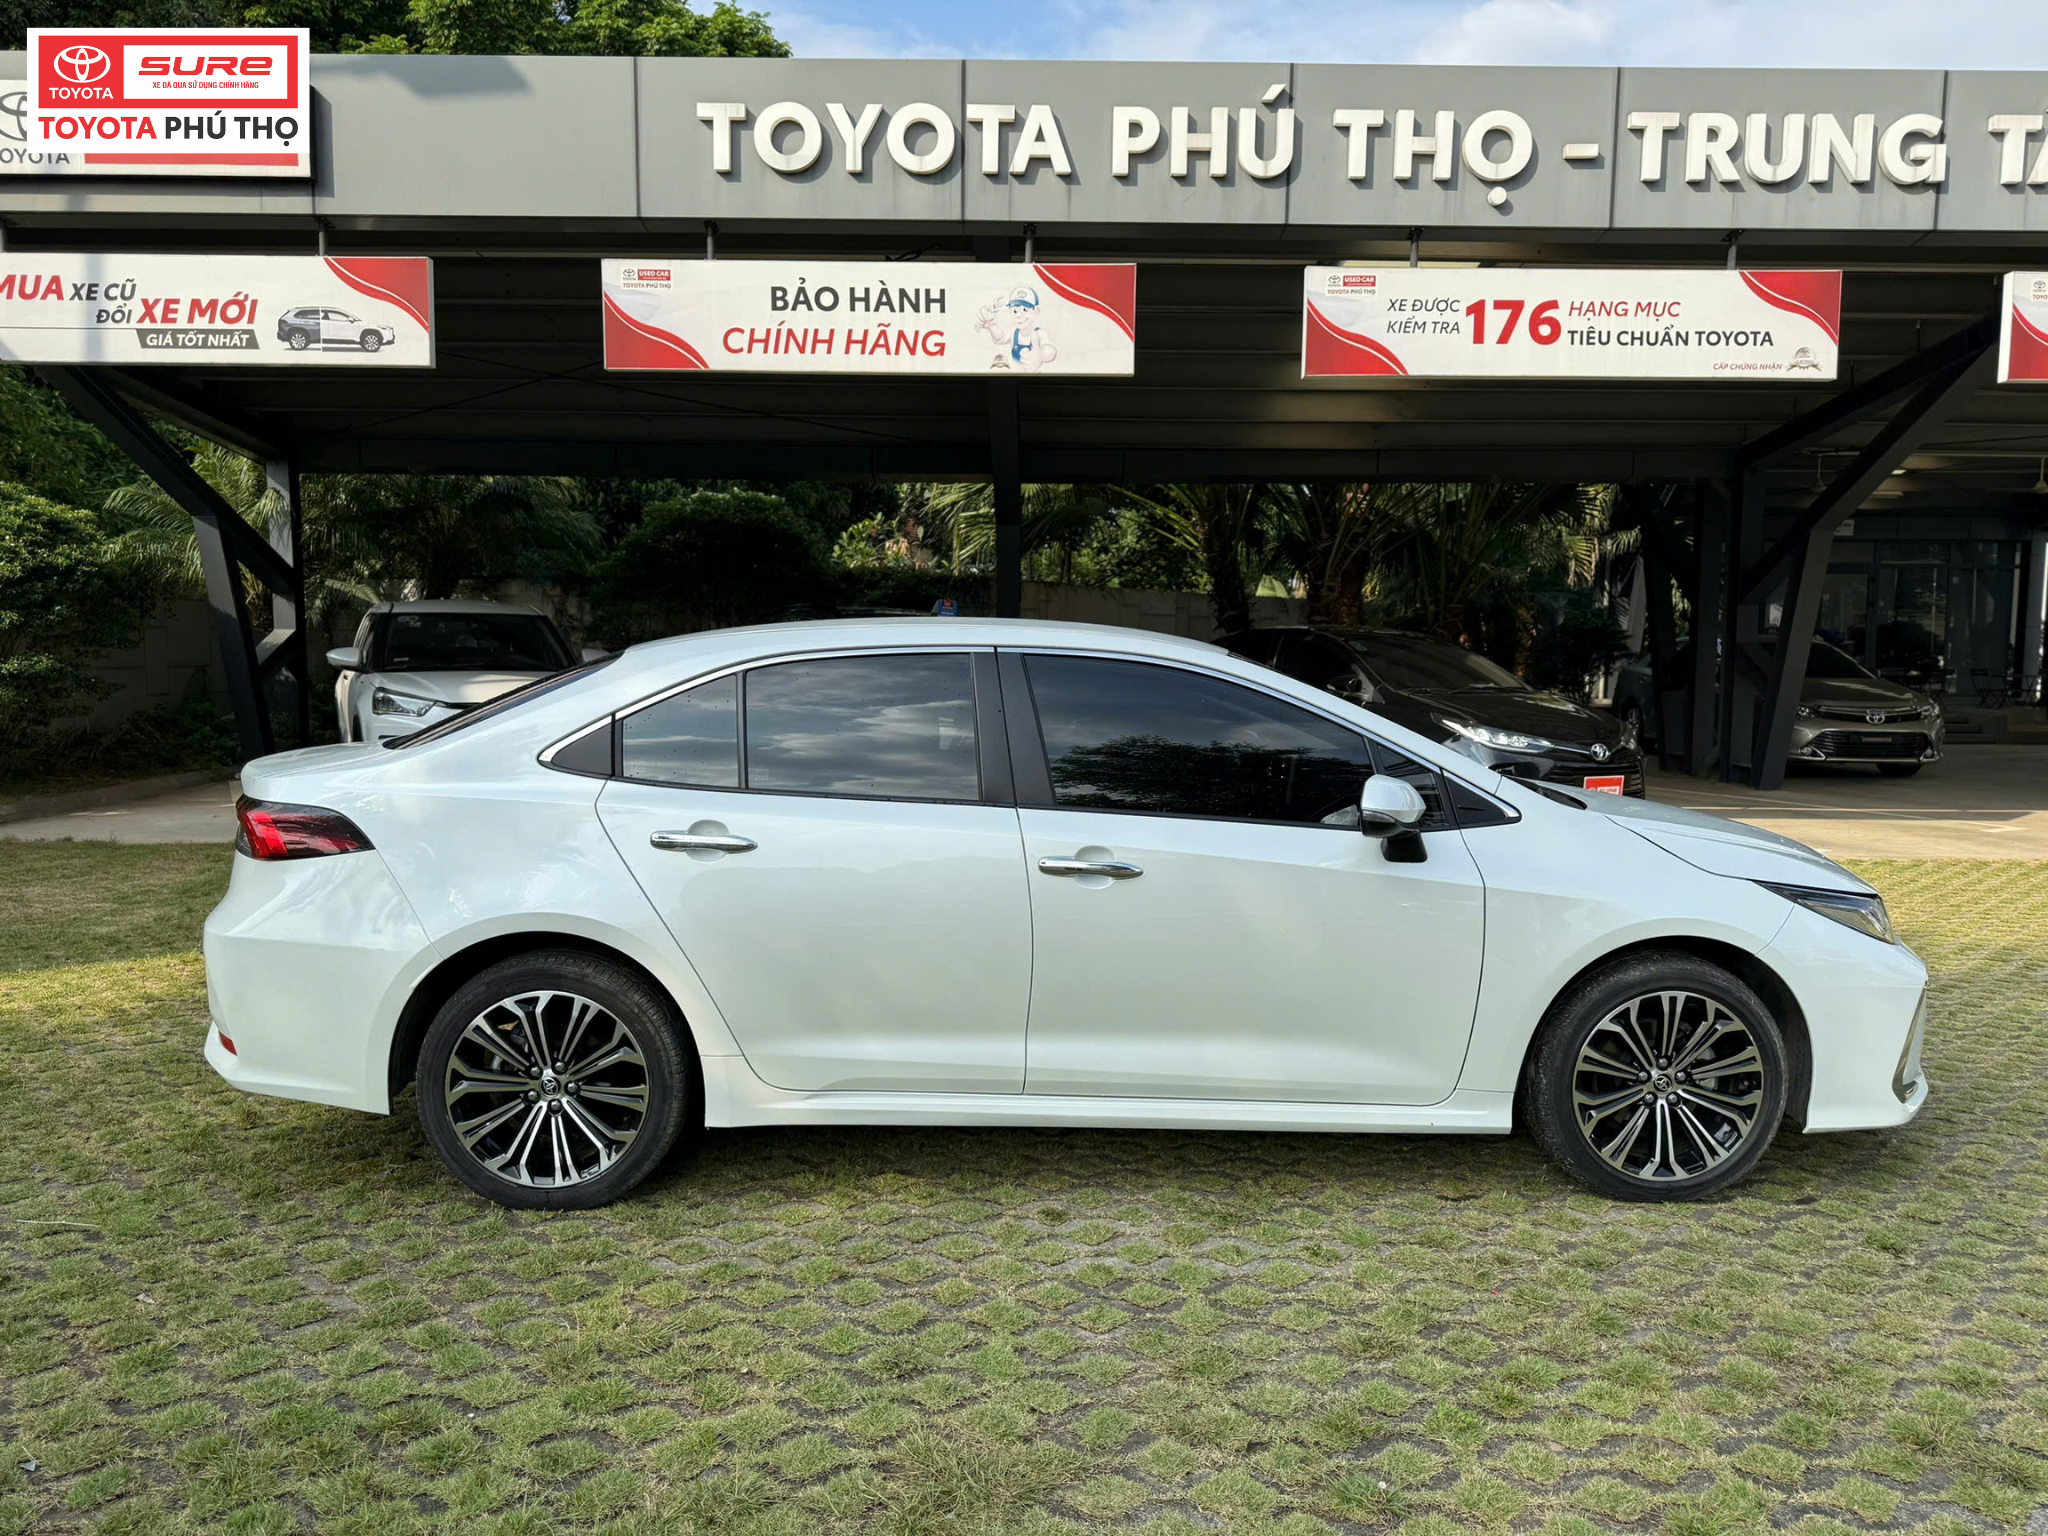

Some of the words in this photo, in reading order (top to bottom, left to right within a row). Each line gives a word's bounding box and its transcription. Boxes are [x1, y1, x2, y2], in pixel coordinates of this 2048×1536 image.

[696, 101, 1073, 176] TOYOTA
[1112, 83, 1295, 179] PHÚ
[1333, 108, 1533, 207] THỌ
[1627, 111, 1947, 185] TRUNG
[0, 274, 64, 300] MUA
[69, 283, 99, 301] XE
[103, 278, 137, 301] CŨ
[770, 277, 840, 312] BẢO
[849, 280, 946, 313] HÀNH
[96, 303, 133, 324] ĐỔI
[136, 298, 181, 325] XE
[187, 291, 258, 325] MỚI
[1387, 298, 1408, 312] XE
[1411, 297, 1460, 317] ĐƯỢC
[1568, 301, 1629, 321] HẠNG
[1634, 301, 1681, 322] MỤC
[1386, 315, 1427, 334] KIỂM
[1432, 321, 1460, 334] TRA
[1465, 299, 1562, 345] 176
[1567, 326, 1611, 346] TIÊU
[1616, 324, 1689, 346] CHUẨN
[1695, 331, 1774, 346] TOYOTA
[146, 331, 174, 347] GIÁ
[176, 331, 206, 347] TỐT
[207, 331, 250, 347] NHẤT
[722, 320, 835, 354] CHÍNH
[844, 322, 946, 357] HÃNG
